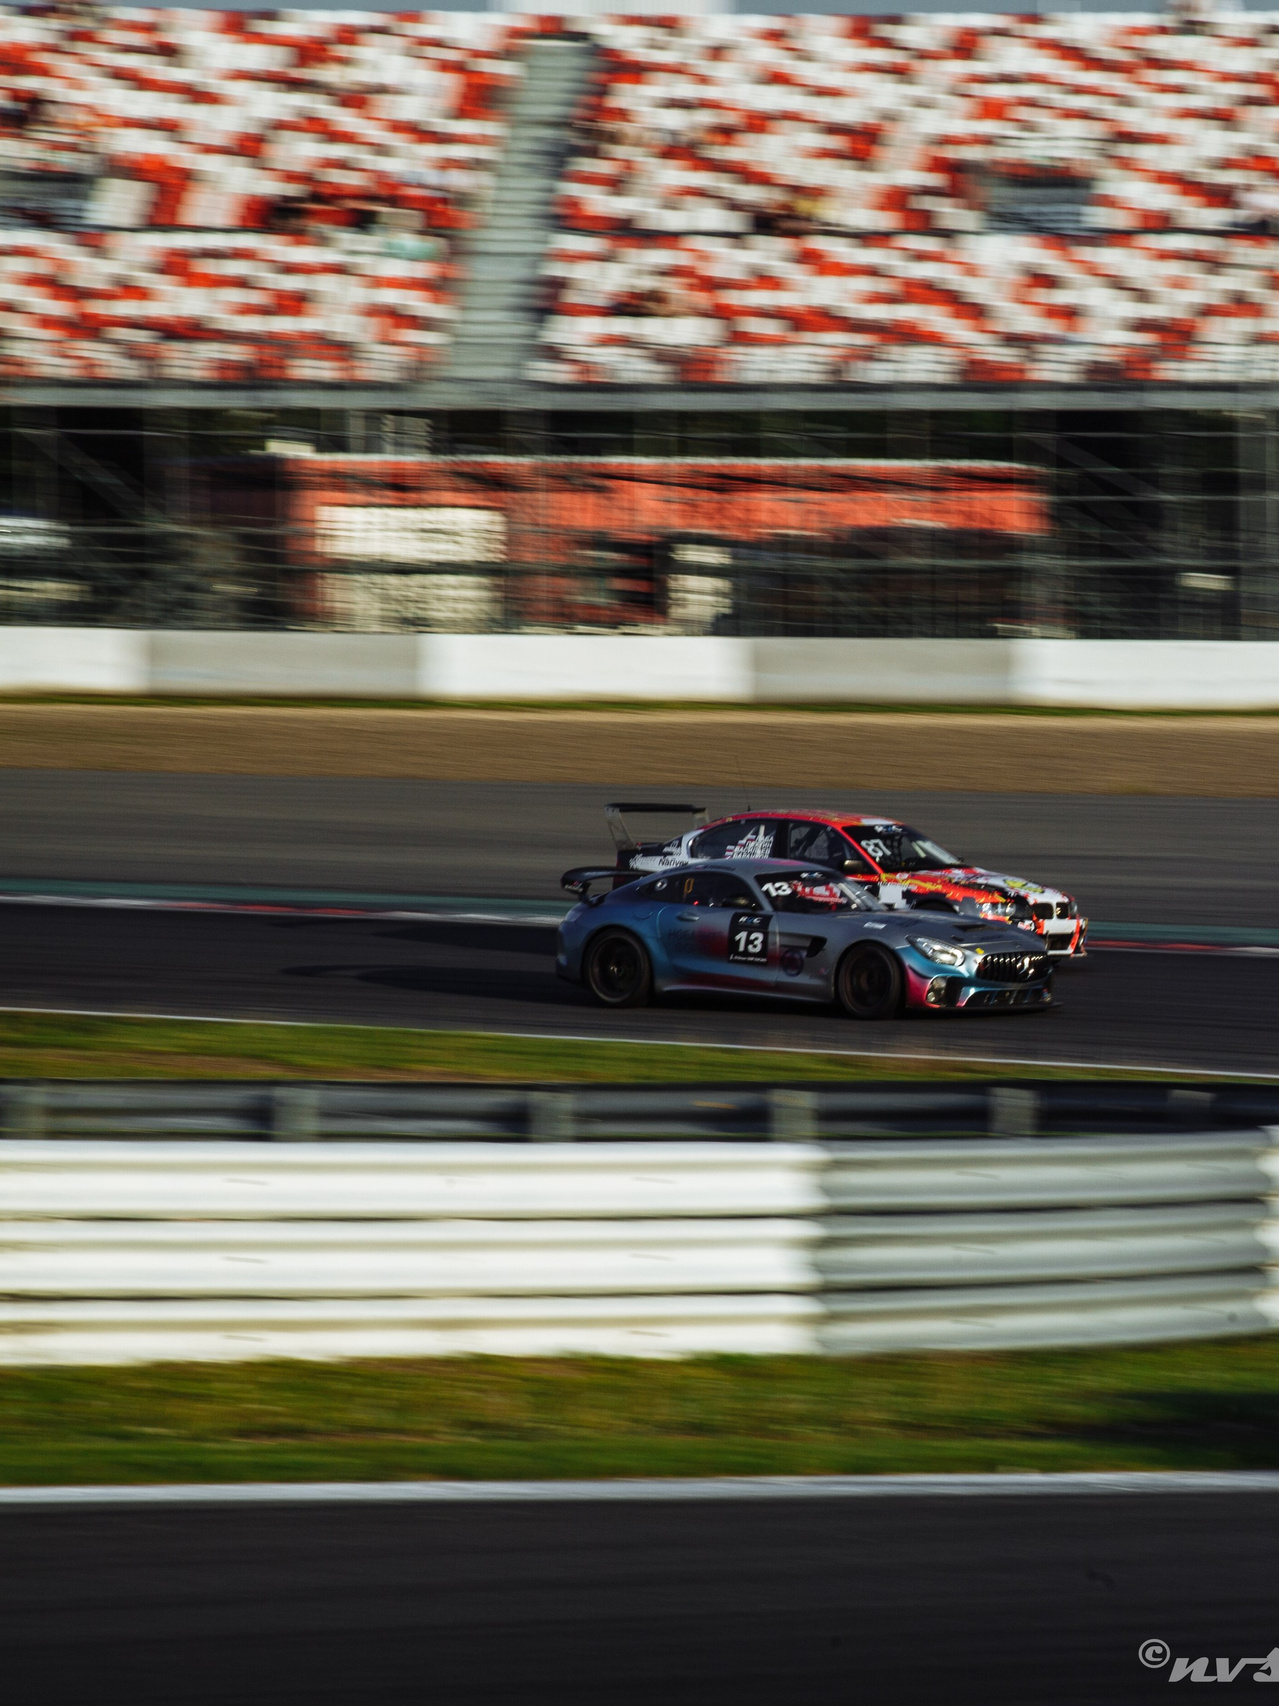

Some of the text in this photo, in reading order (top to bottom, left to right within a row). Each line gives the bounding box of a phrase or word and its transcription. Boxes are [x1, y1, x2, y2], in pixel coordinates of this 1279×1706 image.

[860, 839, 892, 858] 87
[761, 881, 793, 897] 13
[734, 931, 764, 954] 13
